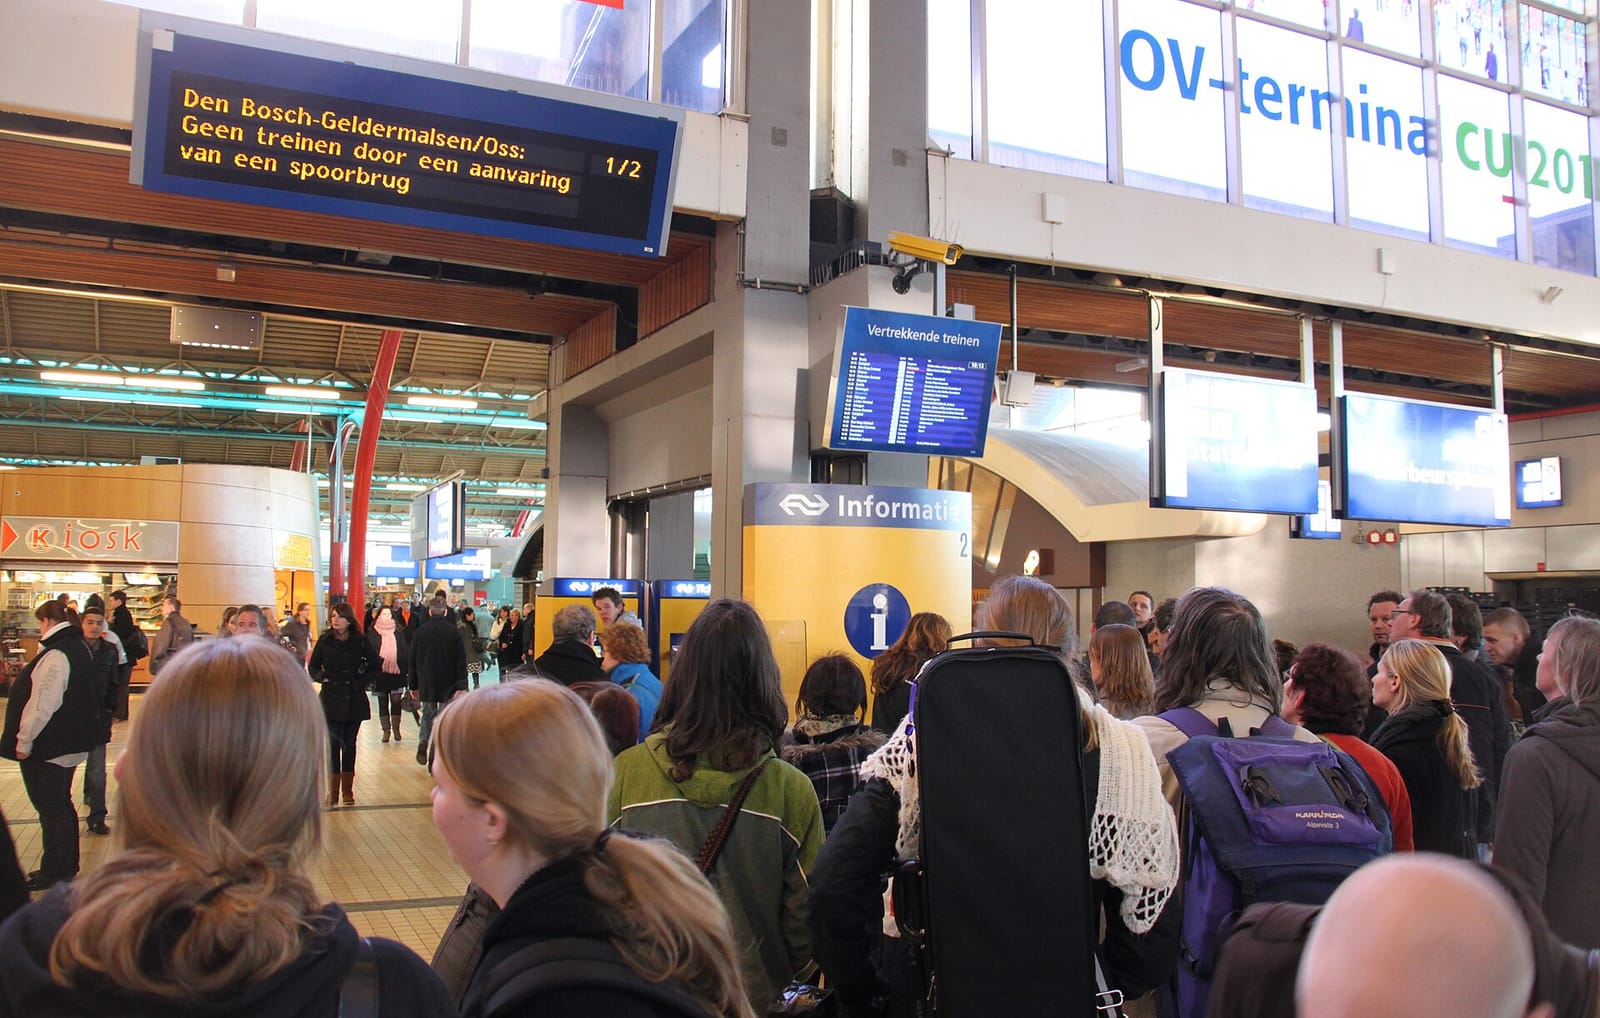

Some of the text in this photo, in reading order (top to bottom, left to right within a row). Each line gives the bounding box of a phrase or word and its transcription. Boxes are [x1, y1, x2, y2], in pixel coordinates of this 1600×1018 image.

[1119, 29, 1436, 158] OV-termina
[182, 88, 526, 160] Den Bosch-Geldermalsen/Oss:
[179, 144, 411, 195] van een spoorbrug
[181, 115, 571, 194] Geen treinen door een aanvaring
[606, 156, 642, 179] 1/2
[867, 323, 980, 347] Vertrekkende treinen
[31, 521, 143, 552] Kiosk
[960, 532, 968, 558] 2
